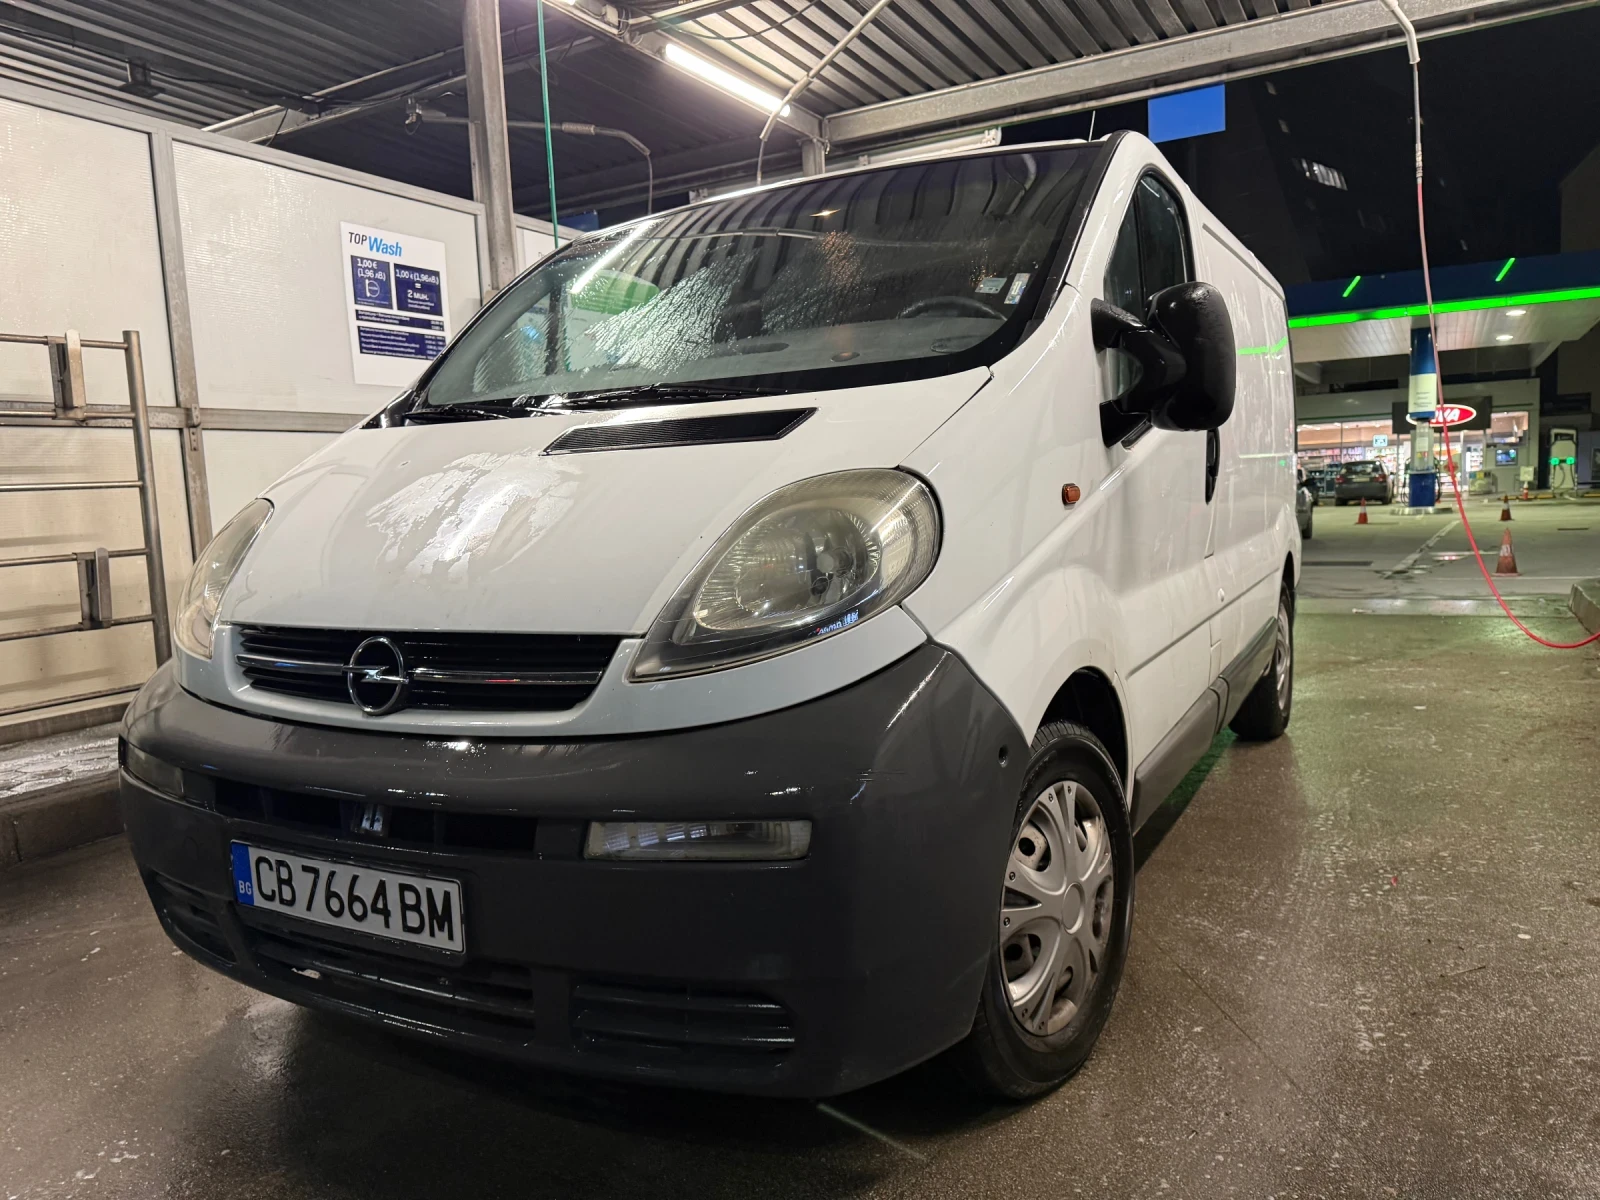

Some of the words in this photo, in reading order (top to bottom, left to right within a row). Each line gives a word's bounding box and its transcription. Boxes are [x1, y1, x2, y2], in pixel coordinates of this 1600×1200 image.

[349, 232, 367, 245] TOP
[368, 236, 402, 257] Wash
[407, 289, 413, 299] 2
[238, 880, 252, 895] BG
